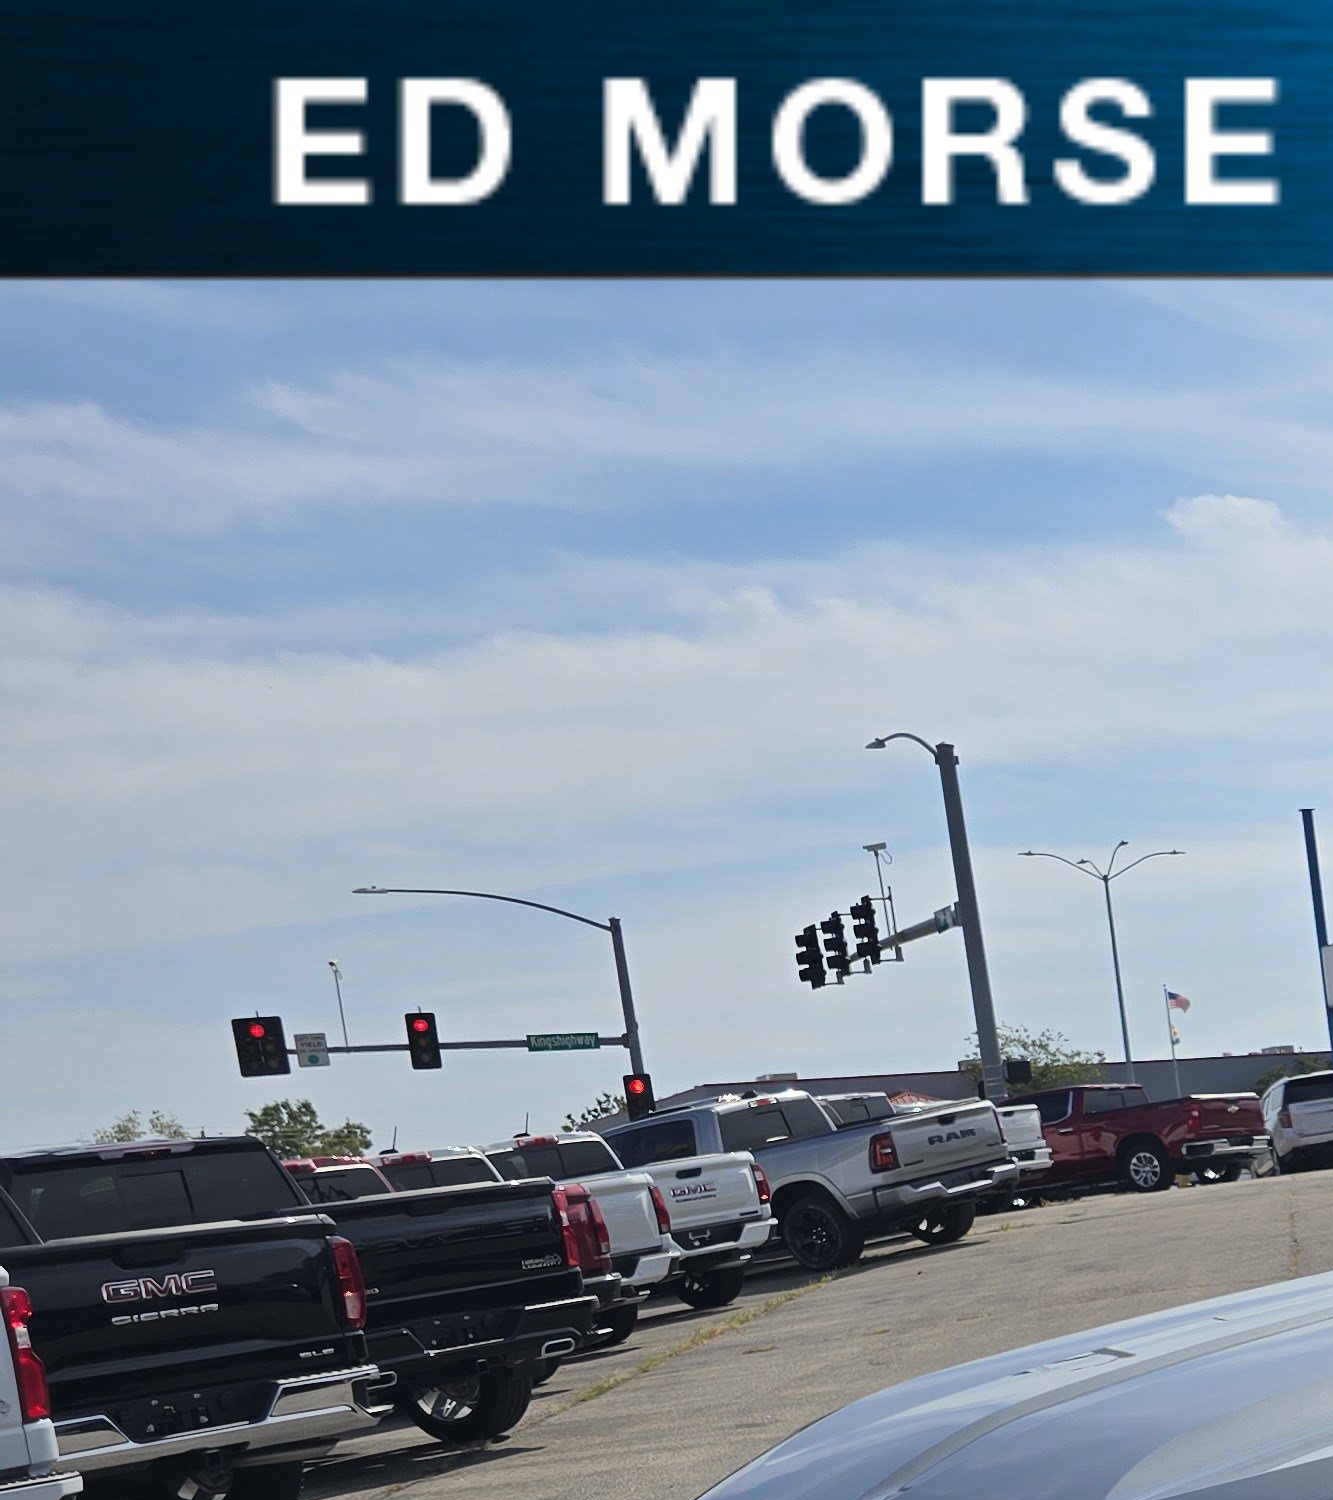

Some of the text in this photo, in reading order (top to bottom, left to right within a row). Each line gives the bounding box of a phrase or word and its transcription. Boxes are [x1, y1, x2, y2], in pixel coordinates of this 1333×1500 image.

[530, 1034, 596, 1049] Kingshighway
[927, 1128, 976, 1145] RAM
[101, 1269, 218, 1304] GMC
[111, 1303, 219, 1326] SIERRA
